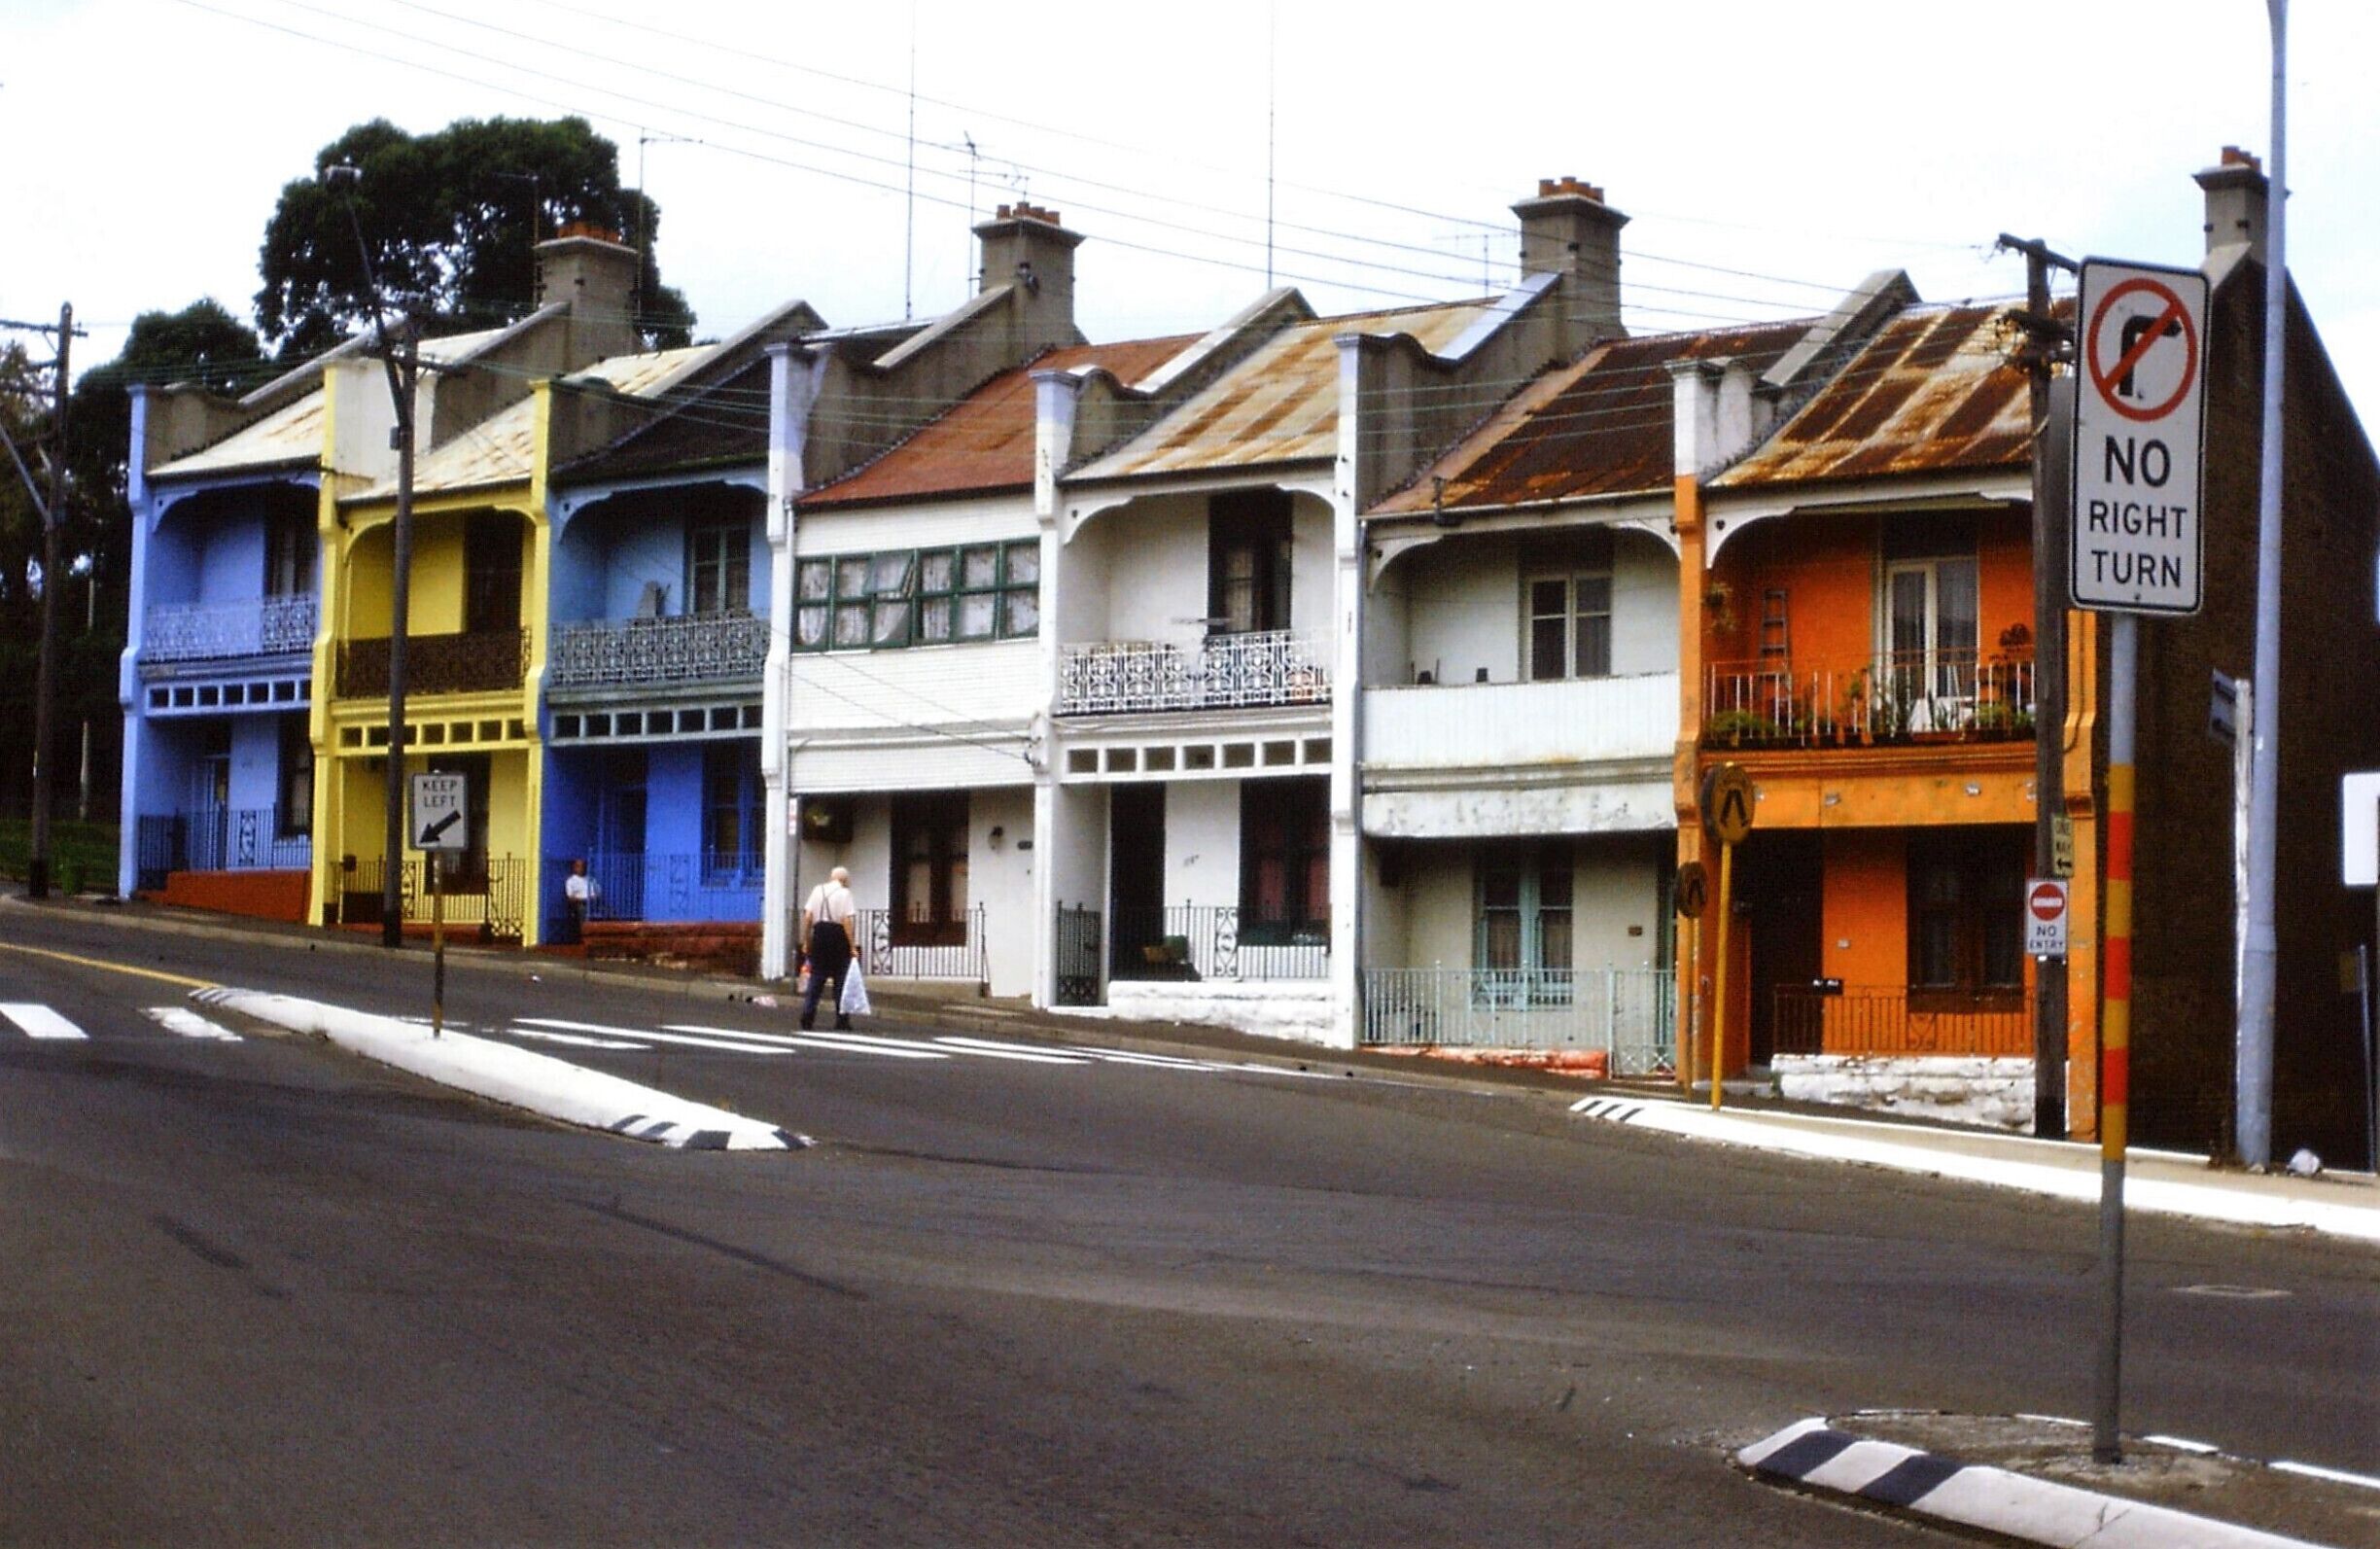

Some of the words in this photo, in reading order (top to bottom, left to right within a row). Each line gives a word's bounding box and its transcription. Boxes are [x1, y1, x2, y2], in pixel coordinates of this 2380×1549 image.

[2104, 435, 2171, 487] NO
[2088, 500, 2188, 540] RIGHT
[2091, 549, 2182, 588] TURN
[422, 780, 457, 792] KEEP
[423, 795, 455, 807] LEFT
[2036, 925, 2057, 937] NO
[2029, 939, 2063, 949] ENTRY
